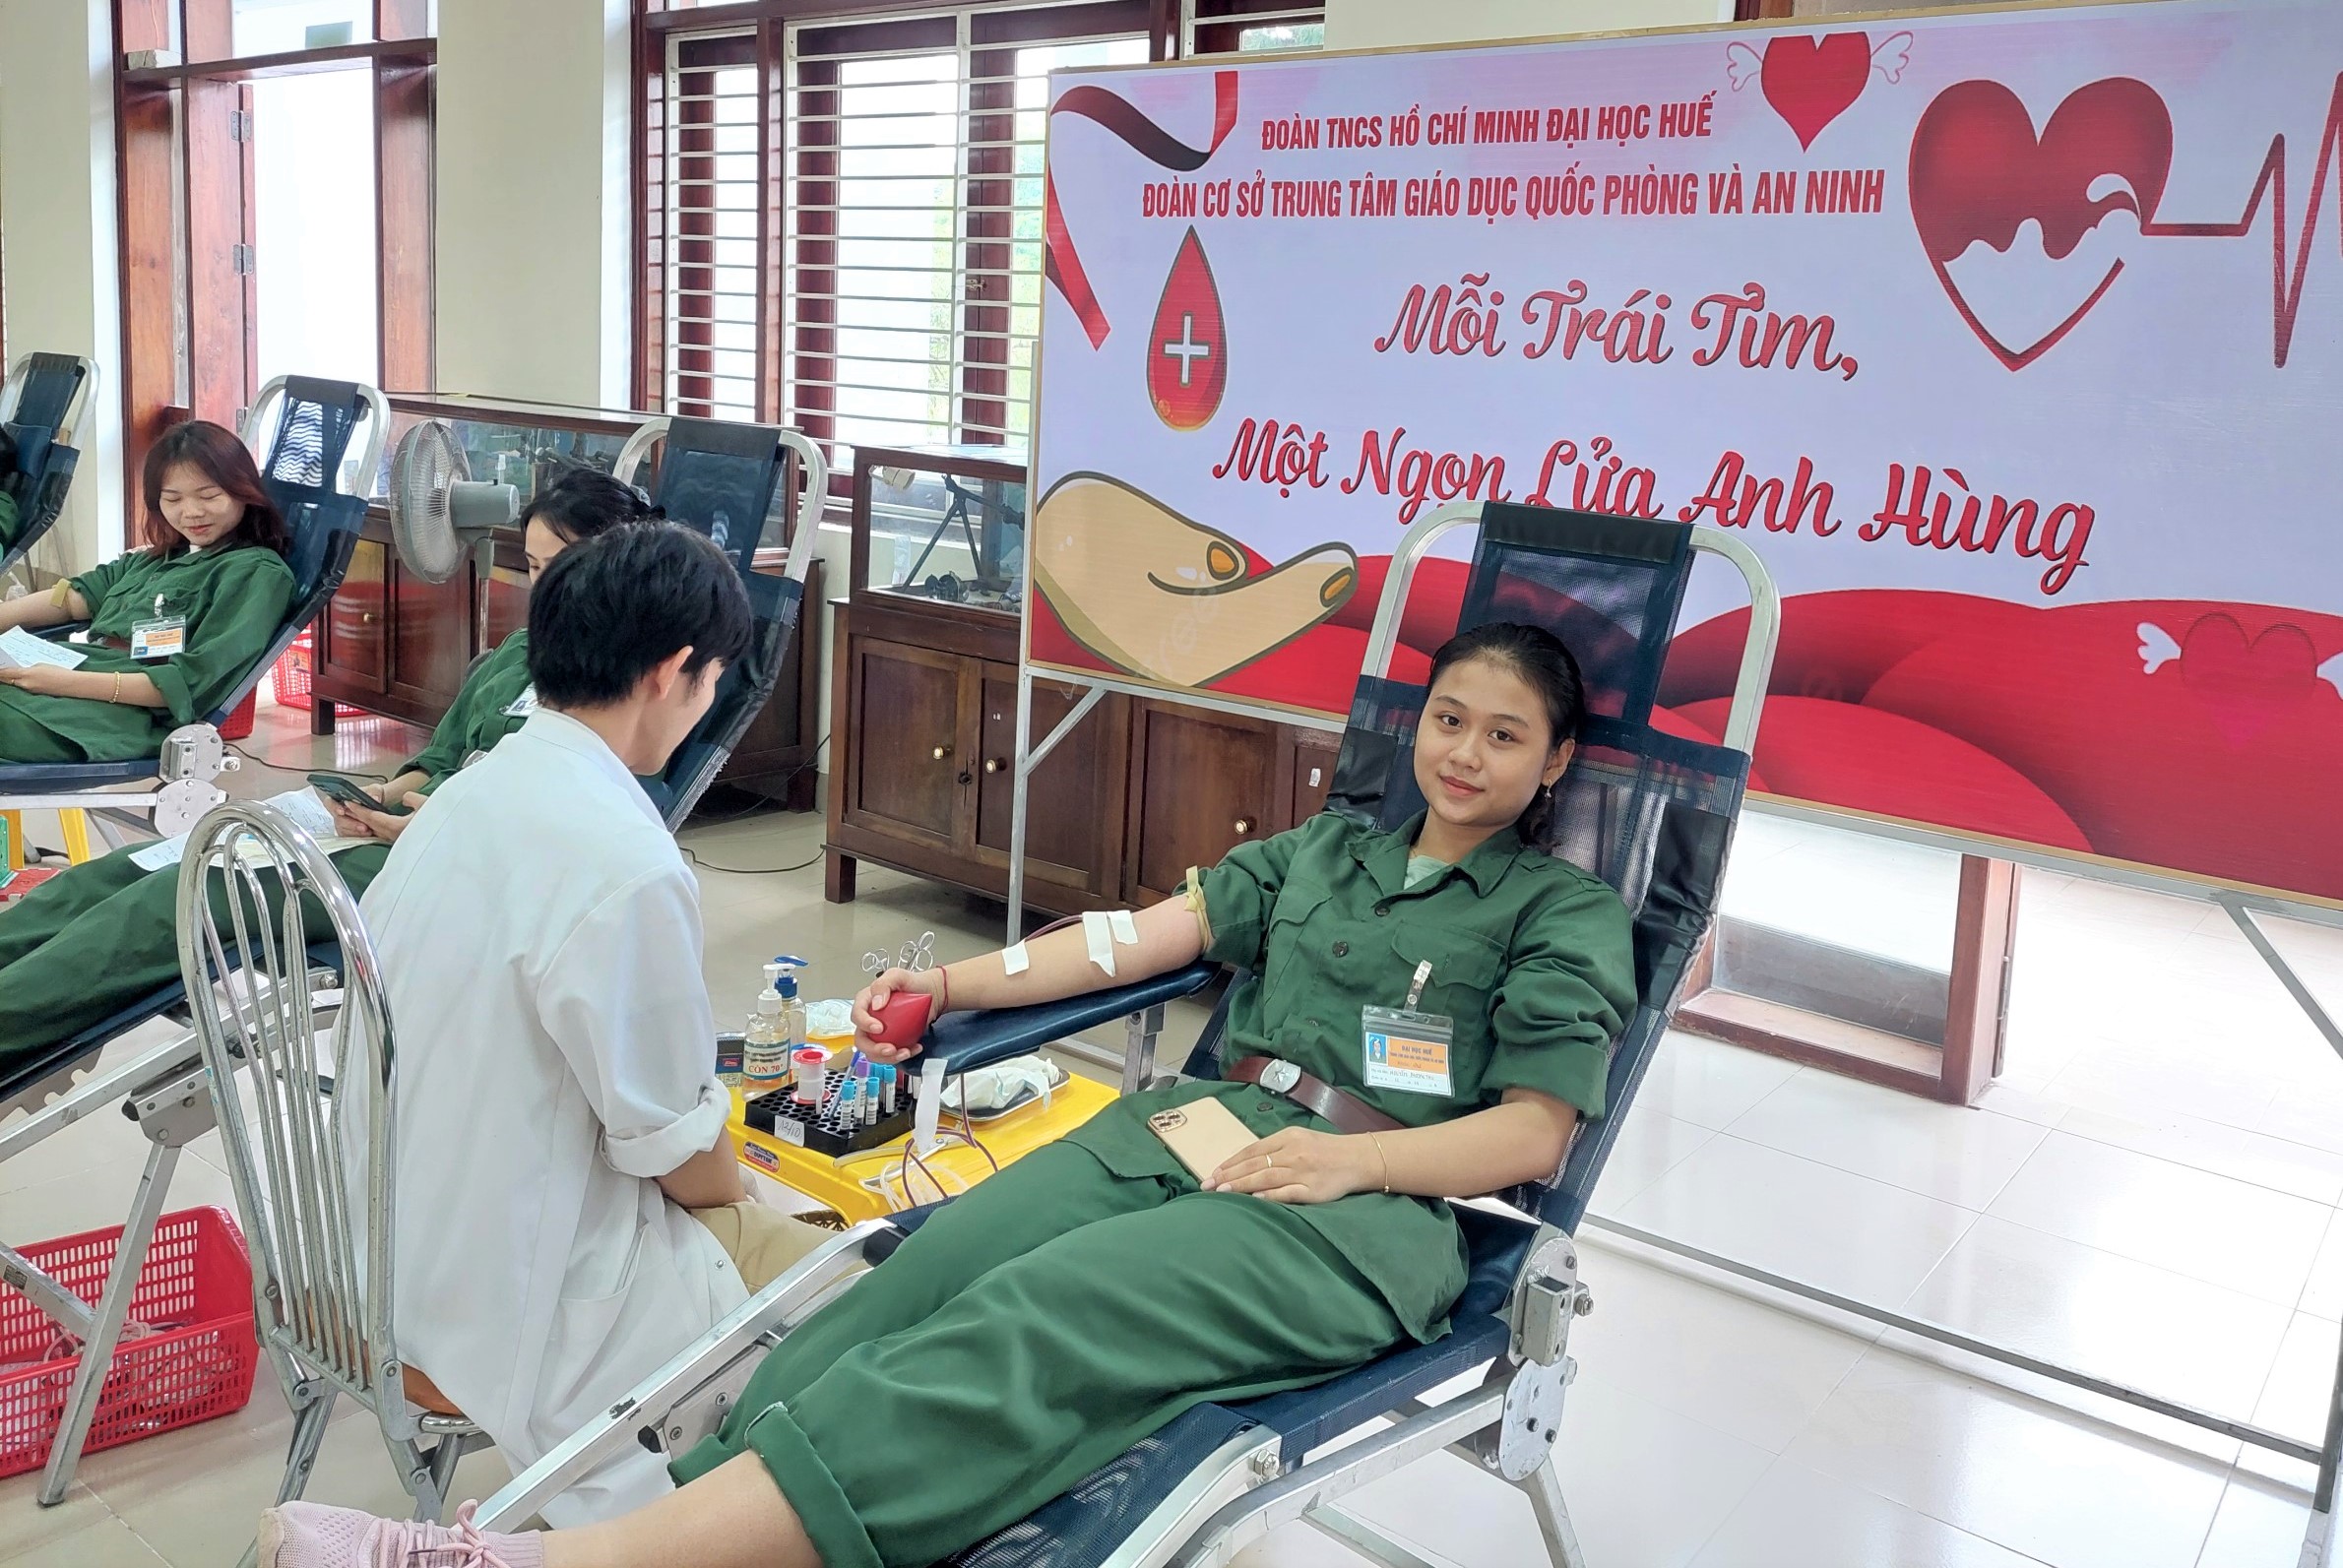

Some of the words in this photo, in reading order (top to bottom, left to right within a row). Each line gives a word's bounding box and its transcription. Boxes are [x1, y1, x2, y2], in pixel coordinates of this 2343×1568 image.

[1262, 114, 1319, 150] ĐOÀN
[1327, 116, 1381, 147] TNCS
[1389, 103, 1421, 146] HỒ
[1428, 105, 1467, 145] CHÍ
[1474, 109, 1540, 143] MINH
[1546, 107, 1590, 148] ĐẠI
[1597, 104, 1650, 146] HỌC
[1659, 91, 1717, 138] HUẾ
[1143, 175, 1197, 218] ĐOÀN
[1204, 180, 1231, 217] CƠ
[1236, 169, 1265, 217] SỞ
[1272, 181, 1341, 217] TRUNG
[1350, 171, 1396, 217] TÂM
[1404, 170, 1461, 217] GIÁO
[1468, 177, 1518, 223] DỤC
[1525, 161, 1595, 220] QUỐC
[1604, 164, 1698, 215] PHÒNG
[1708, 163, 1742, 214] VÀ
[1752, 172, 1797, 214] AN
[1805, 170, 1884, 213] NINH
[1374, 272, 1506, 355] Mỗi
[1521, 280, 1674, 364] Trái
[1690, 282, 1857, 381] Tim,
[1213, 418, 1327, 497] Một
[1340, 428, 1511, 524] Ngọn
[1525, 437, 1661, 519] Lửa
[1678, 451, 1841, 535] Anh
[1858, 463, 2094, 596] Hùng
